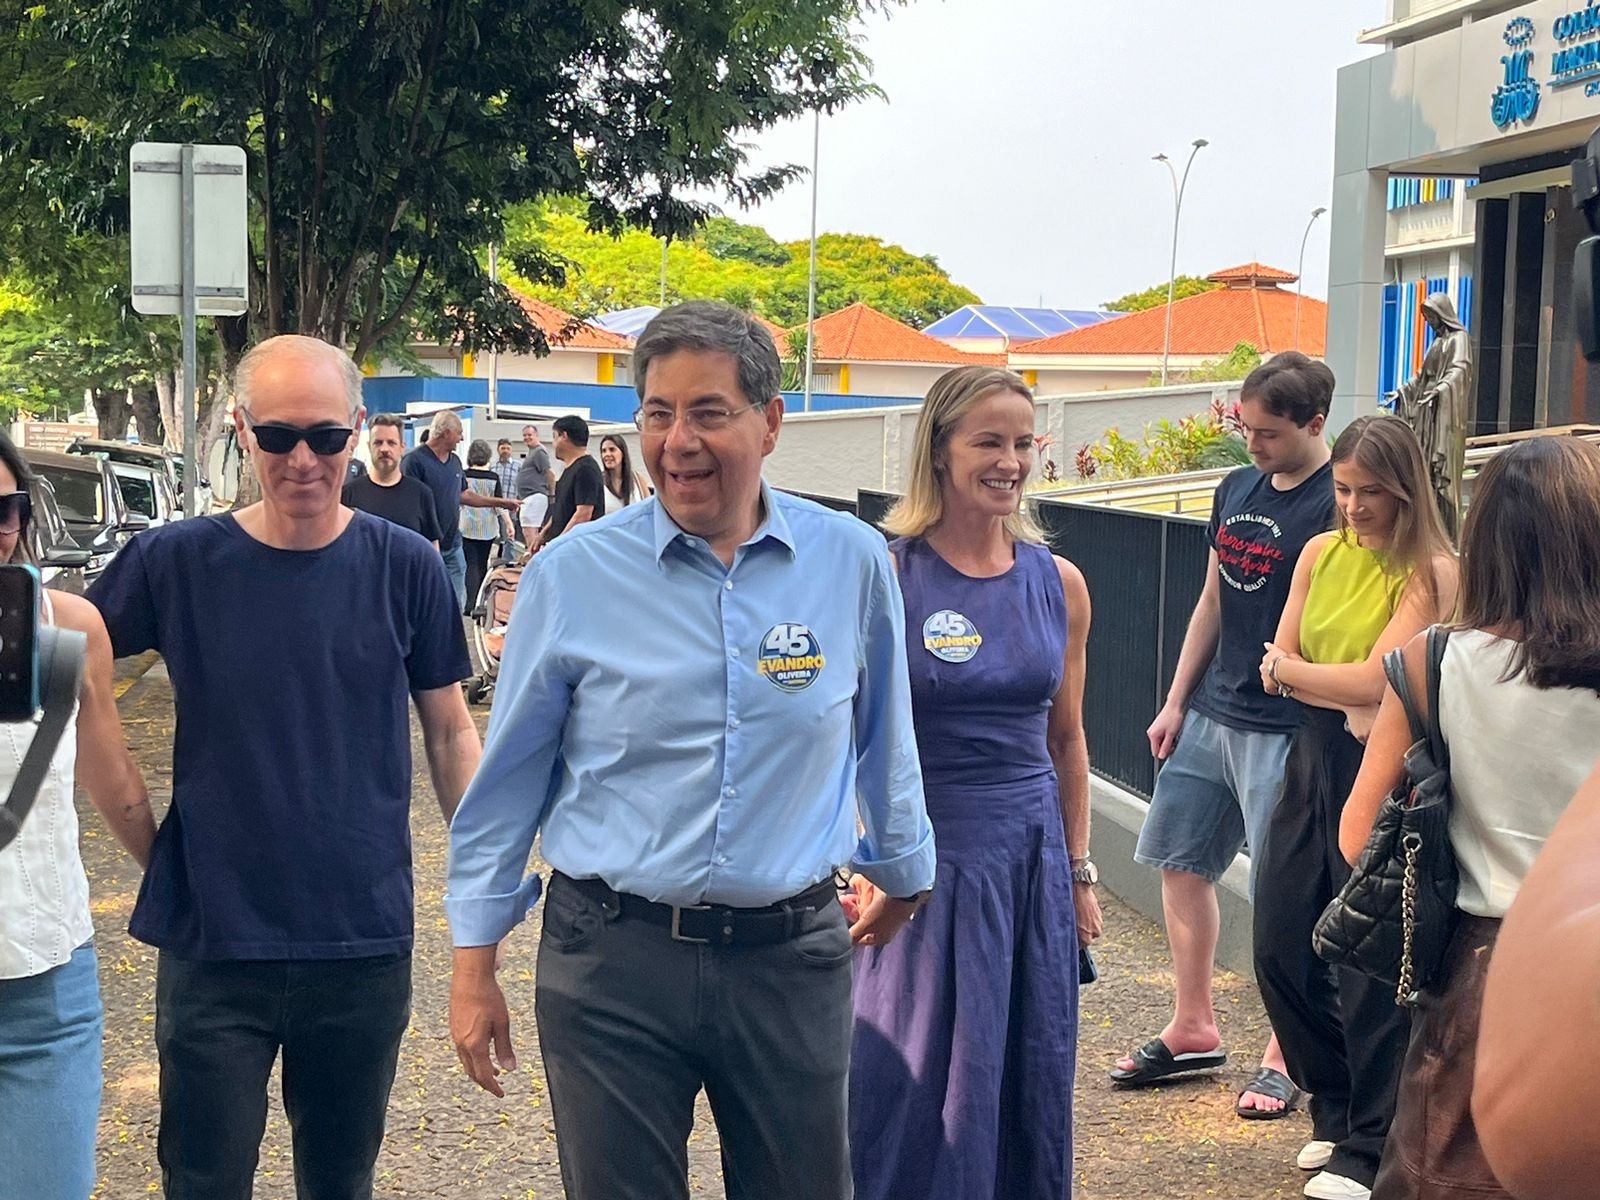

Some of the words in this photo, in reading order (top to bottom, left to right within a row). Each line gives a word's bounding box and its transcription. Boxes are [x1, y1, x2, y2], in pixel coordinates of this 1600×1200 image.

[1226, 513, 1275, 527] ESTABLISHED
[1218, 563, 1242, 589] SUPERIOR
[1243, 576, 1267, 592] QUALITY
[929, 612, 966, 637] 45
[766, 624, 810, 657] 45
[924, 635, 982, 650] EVANDRO
[757, 656, 825, 674] EVANDRO
[777, 670, 811, 680] OLIVEIRA
